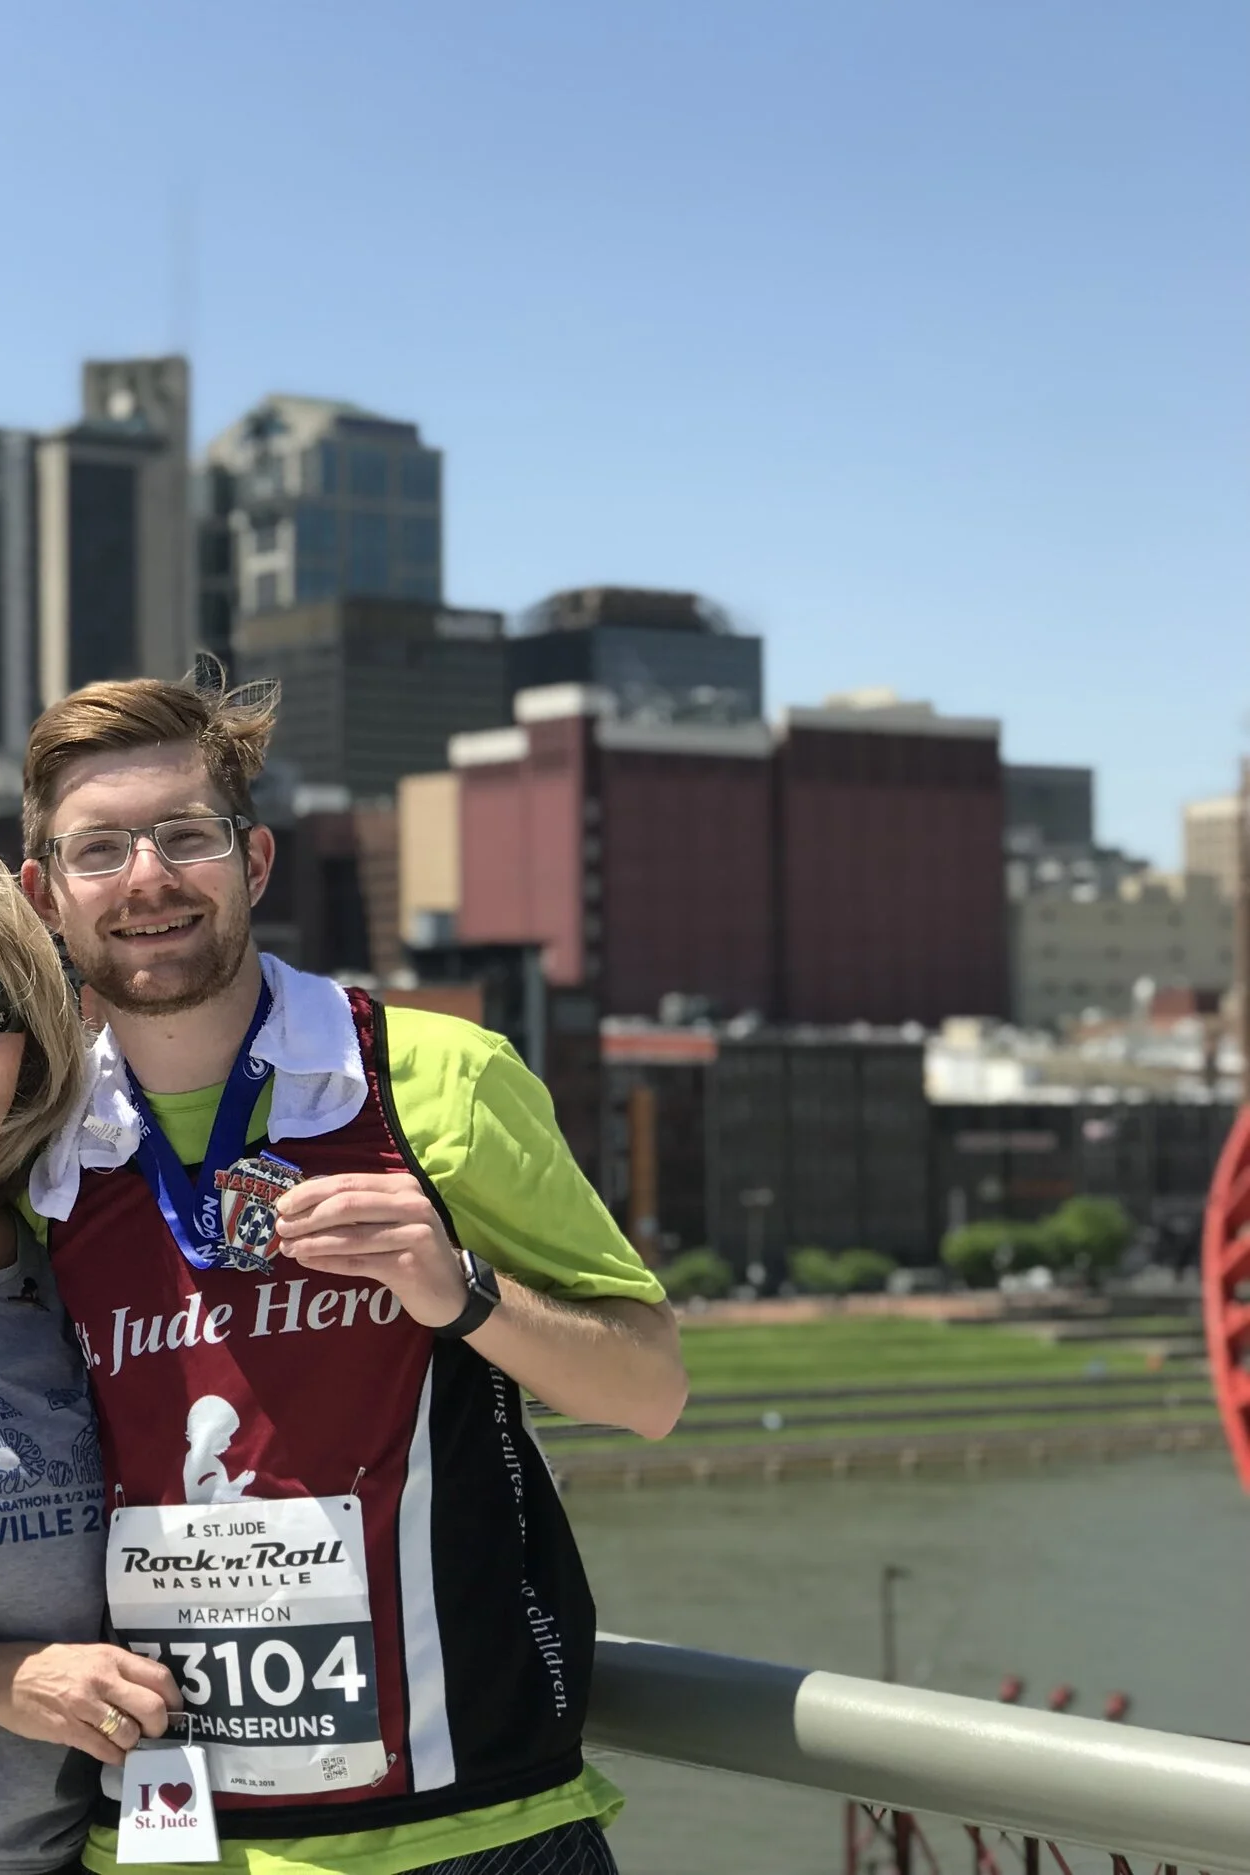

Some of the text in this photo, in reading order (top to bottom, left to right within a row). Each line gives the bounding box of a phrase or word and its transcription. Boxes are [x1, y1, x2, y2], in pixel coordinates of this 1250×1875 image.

[214, 1169, 287, 1203] NASHV
[109, 1291, 233, 1376] Jude
[248, 1278, 402, 1338] Hero
[54, 1494, 64, 1504] &
[65, 1491, 82, 1504] 1/2
[202, 1521, 267, 1538] ST. JUDE
[152, 1571, 312, 1589] NASHVILLE
[178, 1606, 291, 1624] MARATHON
[527, 1606, 567, 1718] children.
[230, 1778, 248, 1786] APRIL
[138, 1783, 153, 1812] I
[135, 1815, 198, 1830] St. Jude
